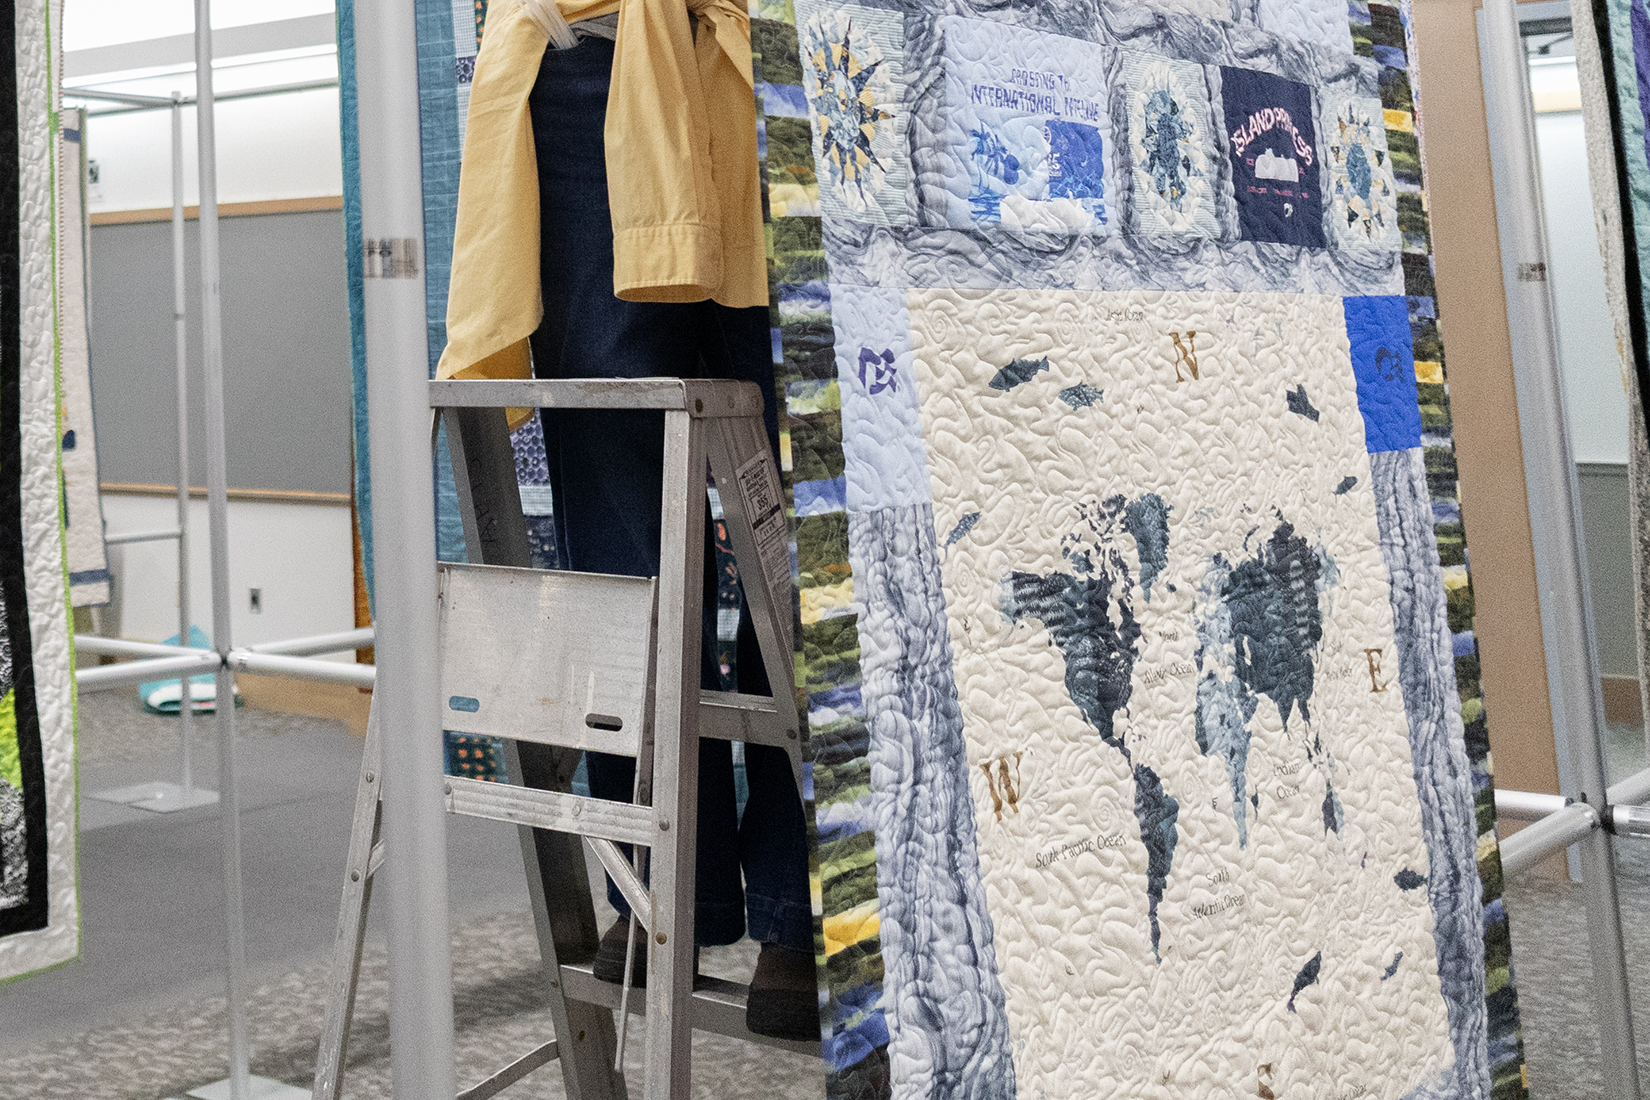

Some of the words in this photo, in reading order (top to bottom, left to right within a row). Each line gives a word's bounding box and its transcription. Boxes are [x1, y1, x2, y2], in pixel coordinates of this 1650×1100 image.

[1168, 330, 1200, 384] N
[1363, 648, 1389, 693] E
[979, 751, 1024, 823] W
[1096, 832, 1127, 852] Ocean
